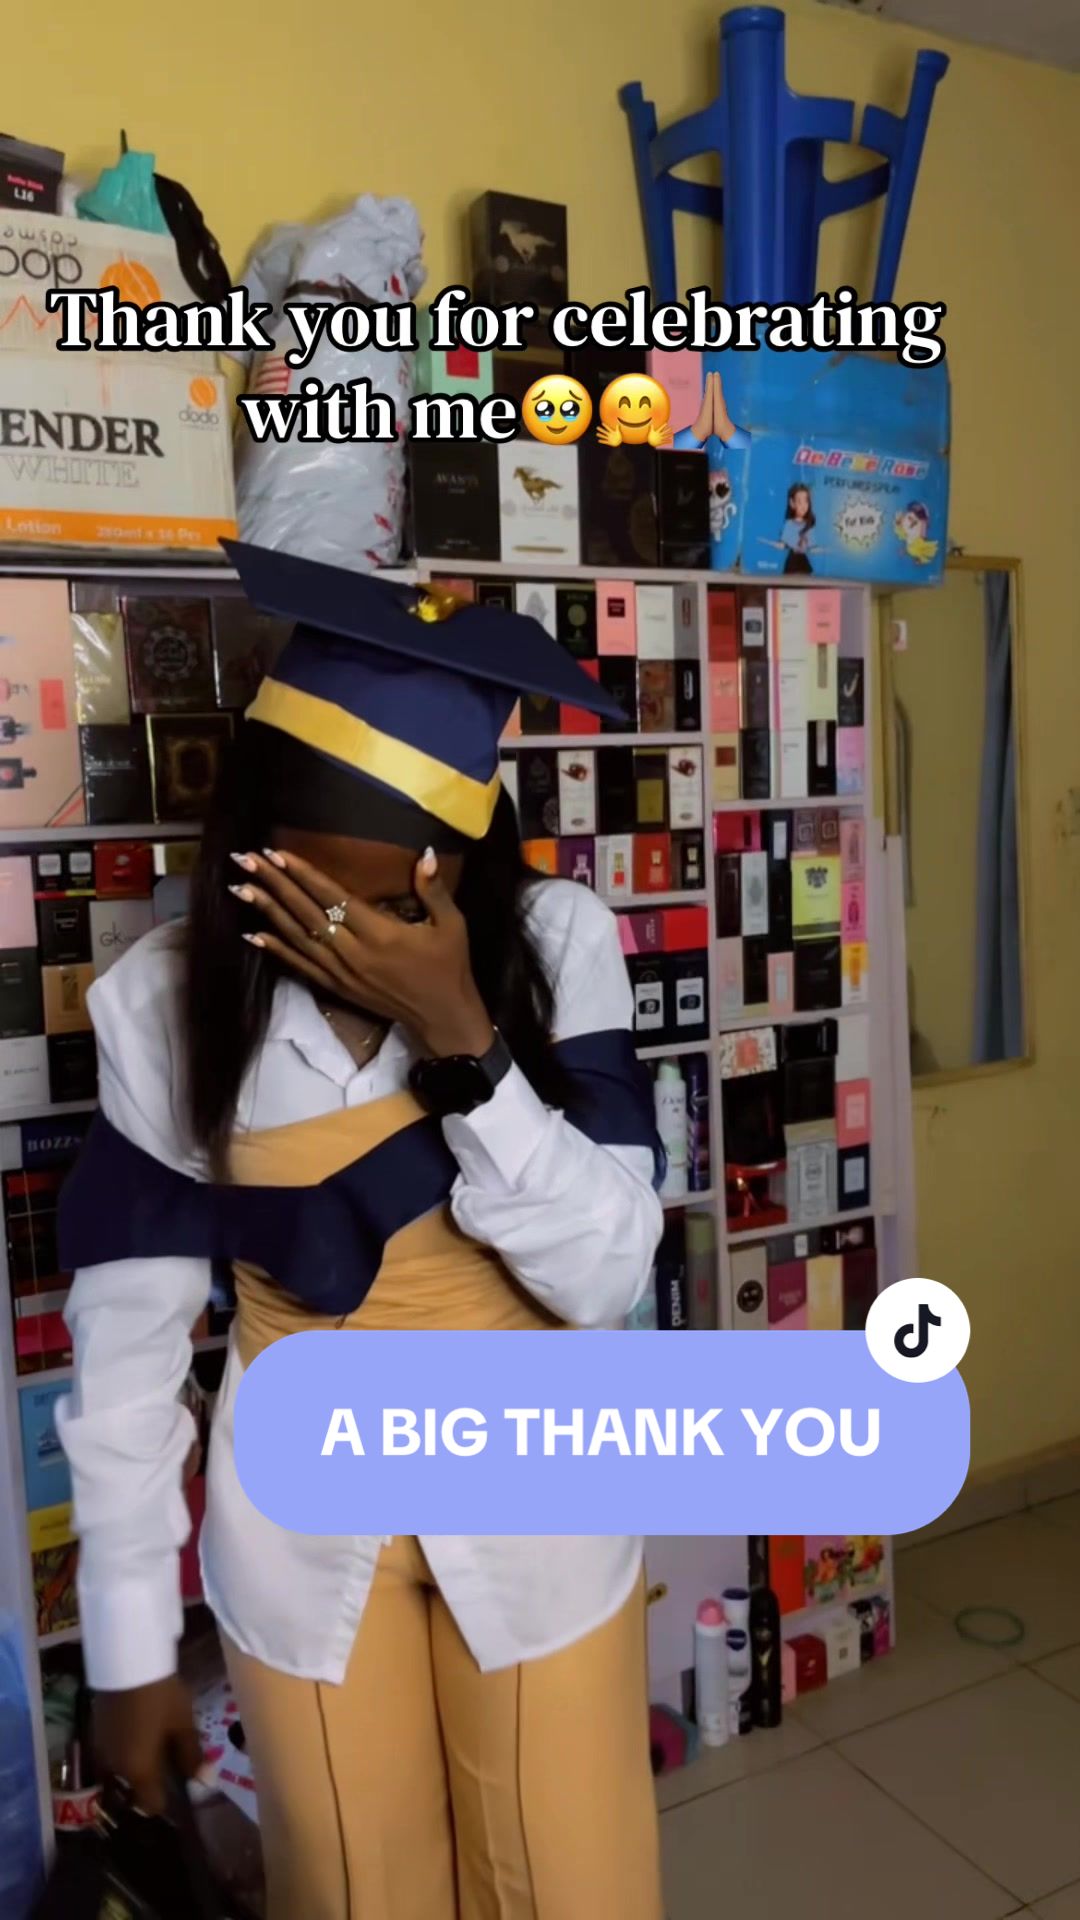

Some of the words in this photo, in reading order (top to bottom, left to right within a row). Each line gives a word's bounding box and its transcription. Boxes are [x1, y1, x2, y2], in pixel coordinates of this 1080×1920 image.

[178, 404, 220, 425] dodo
[0, 408, 165, 457] ENDER
[4, 454, 140, 488] WHITE
